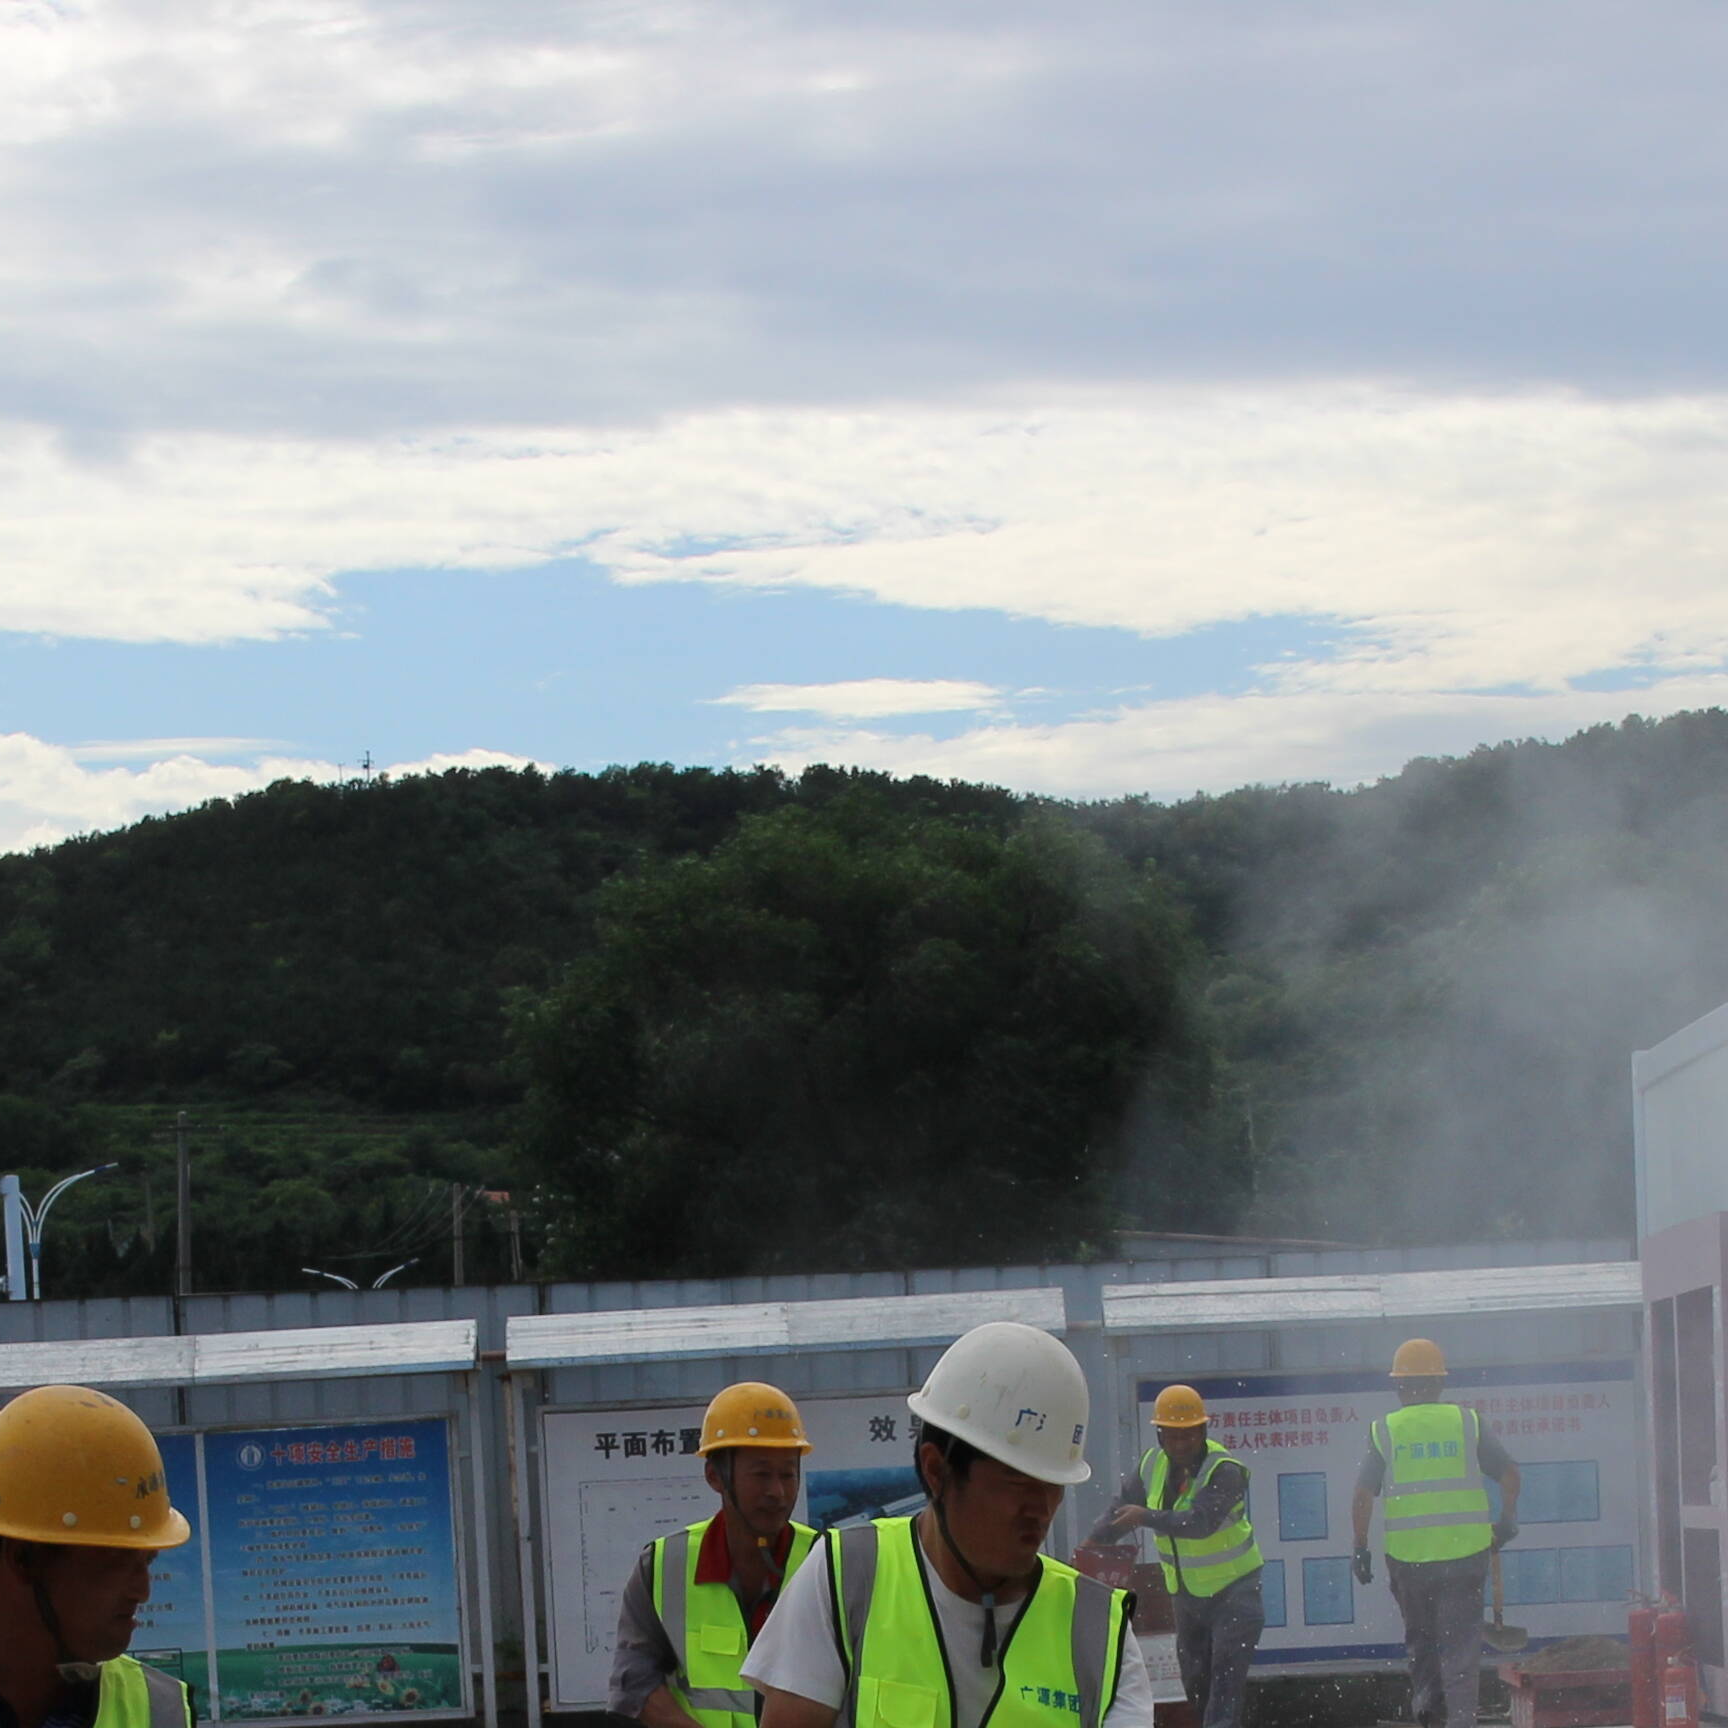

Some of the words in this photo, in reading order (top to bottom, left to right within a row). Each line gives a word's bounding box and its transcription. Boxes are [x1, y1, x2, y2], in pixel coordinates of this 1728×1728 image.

[271, 1437, 416, 1466] 十项安全生产措施
[594, 1428, 700, 1459] 平面布置
[1394, 1440, 1459, 1461] 广源集团
